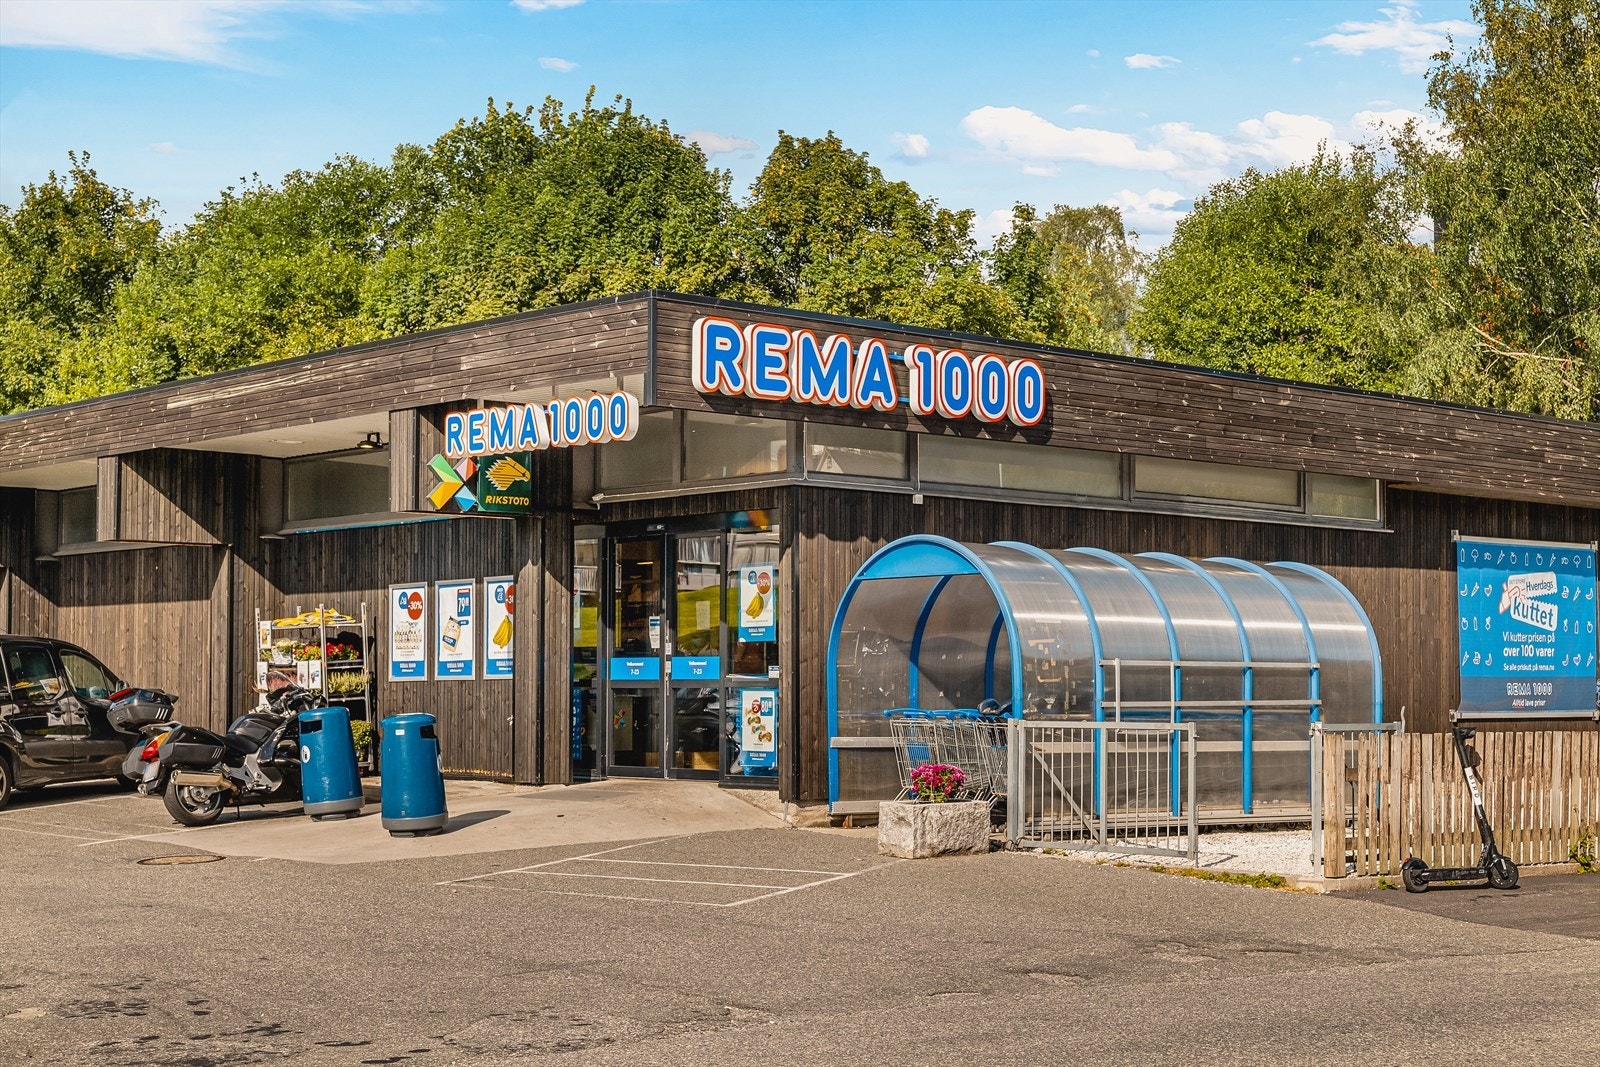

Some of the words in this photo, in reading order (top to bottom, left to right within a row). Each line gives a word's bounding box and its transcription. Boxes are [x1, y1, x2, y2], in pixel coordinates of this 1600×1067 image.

[697, 317, 898, 411] REMA
[908, 345, 1045, 426] 1000
[446, 405, 540, 456] REMA
[549, 393, 628, 446] 1000
[485, 494, 530, 506] RIKSTOTO
[1526, 580, 1554, 592] Hverdags
[407, 600, 423, 611] -30%
[1513, 597, 1554, 628] kuttet
[1502, 631, 1510, 642] Vi
[1510, 631, 1528, 642] kutter
[1528, 632, 1546, 644] prisen
[1547, 632, 1555, 644] på
[1503, 646, 1520, 657] over
[1520, 644, 1534, 657] 100
[1535, 647, 1555, 657] varer
[1506, 682, 1532, 696] REMA
[1532, 682, 1553, 696] 1000
